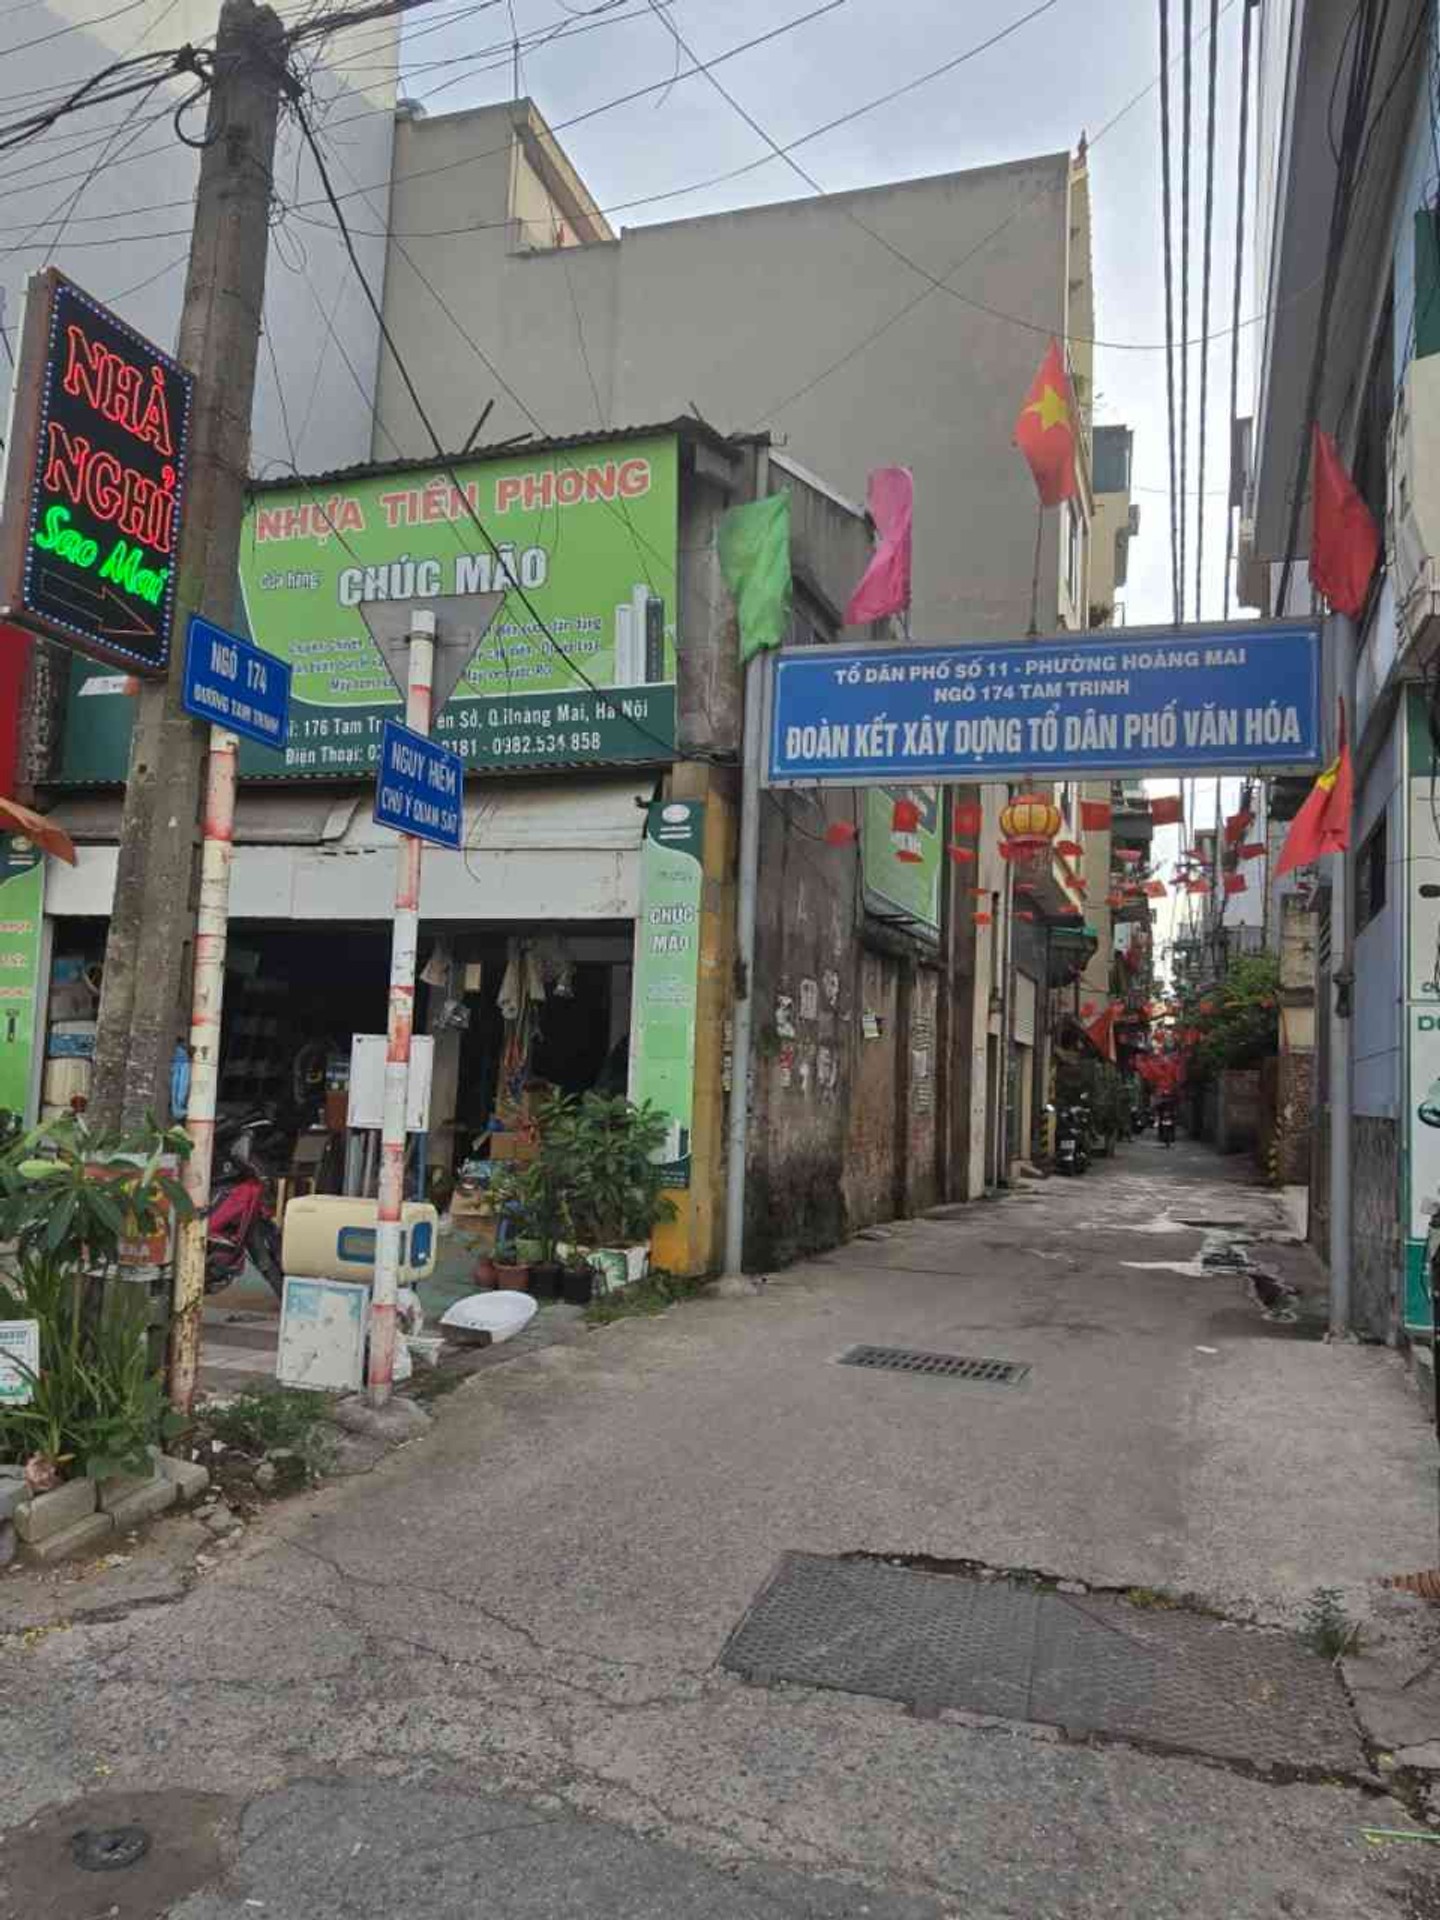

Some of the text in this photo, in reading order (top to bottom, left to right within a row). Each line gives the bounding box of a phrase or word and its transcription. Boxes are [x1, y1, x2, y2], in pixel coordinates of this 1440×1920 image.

[64, 325, 172, 456] NHÀ
[43, 421, 176, 553] NGHỈ
[256, 457, 651, 546] NHỰA TIỀN PHONG
[36, 505, 169, 606] Sao Mai
[338, 541, 550, 608] CHÚC MÃO
[210, 640, 239, 682] NGÕ
[246, 658, 268, 695] 174
[835, 661, 861, 685] TỔ
[865, 666, 904, 683] DÂN
[909, 658, 950, 681] PHỐ
[954, 656, 983, 679] SỐ
[987, 661, 1008, 677] 11
[1025, 653, 1117, 676] PHƯỜNG
[1122, 650, 1199, 671] HOÀNG
[1205, 648, 1247, 666] MAI
[934, 679, 1130, 703] NGÕ 174 TAM TRINH
[304, 719, 329, 738] 176
[332, 717, 362, 735] Tam
[557, 702, 590, 723] Mai,
[621, 697, 648, 721] Nội
[786, 699, 1301, 762] ĐOÀN KẾT XÂY DỰNG TỔ DÂN PHỐ VĂN HÓA
[391, 741, 426, 782] NGUY
